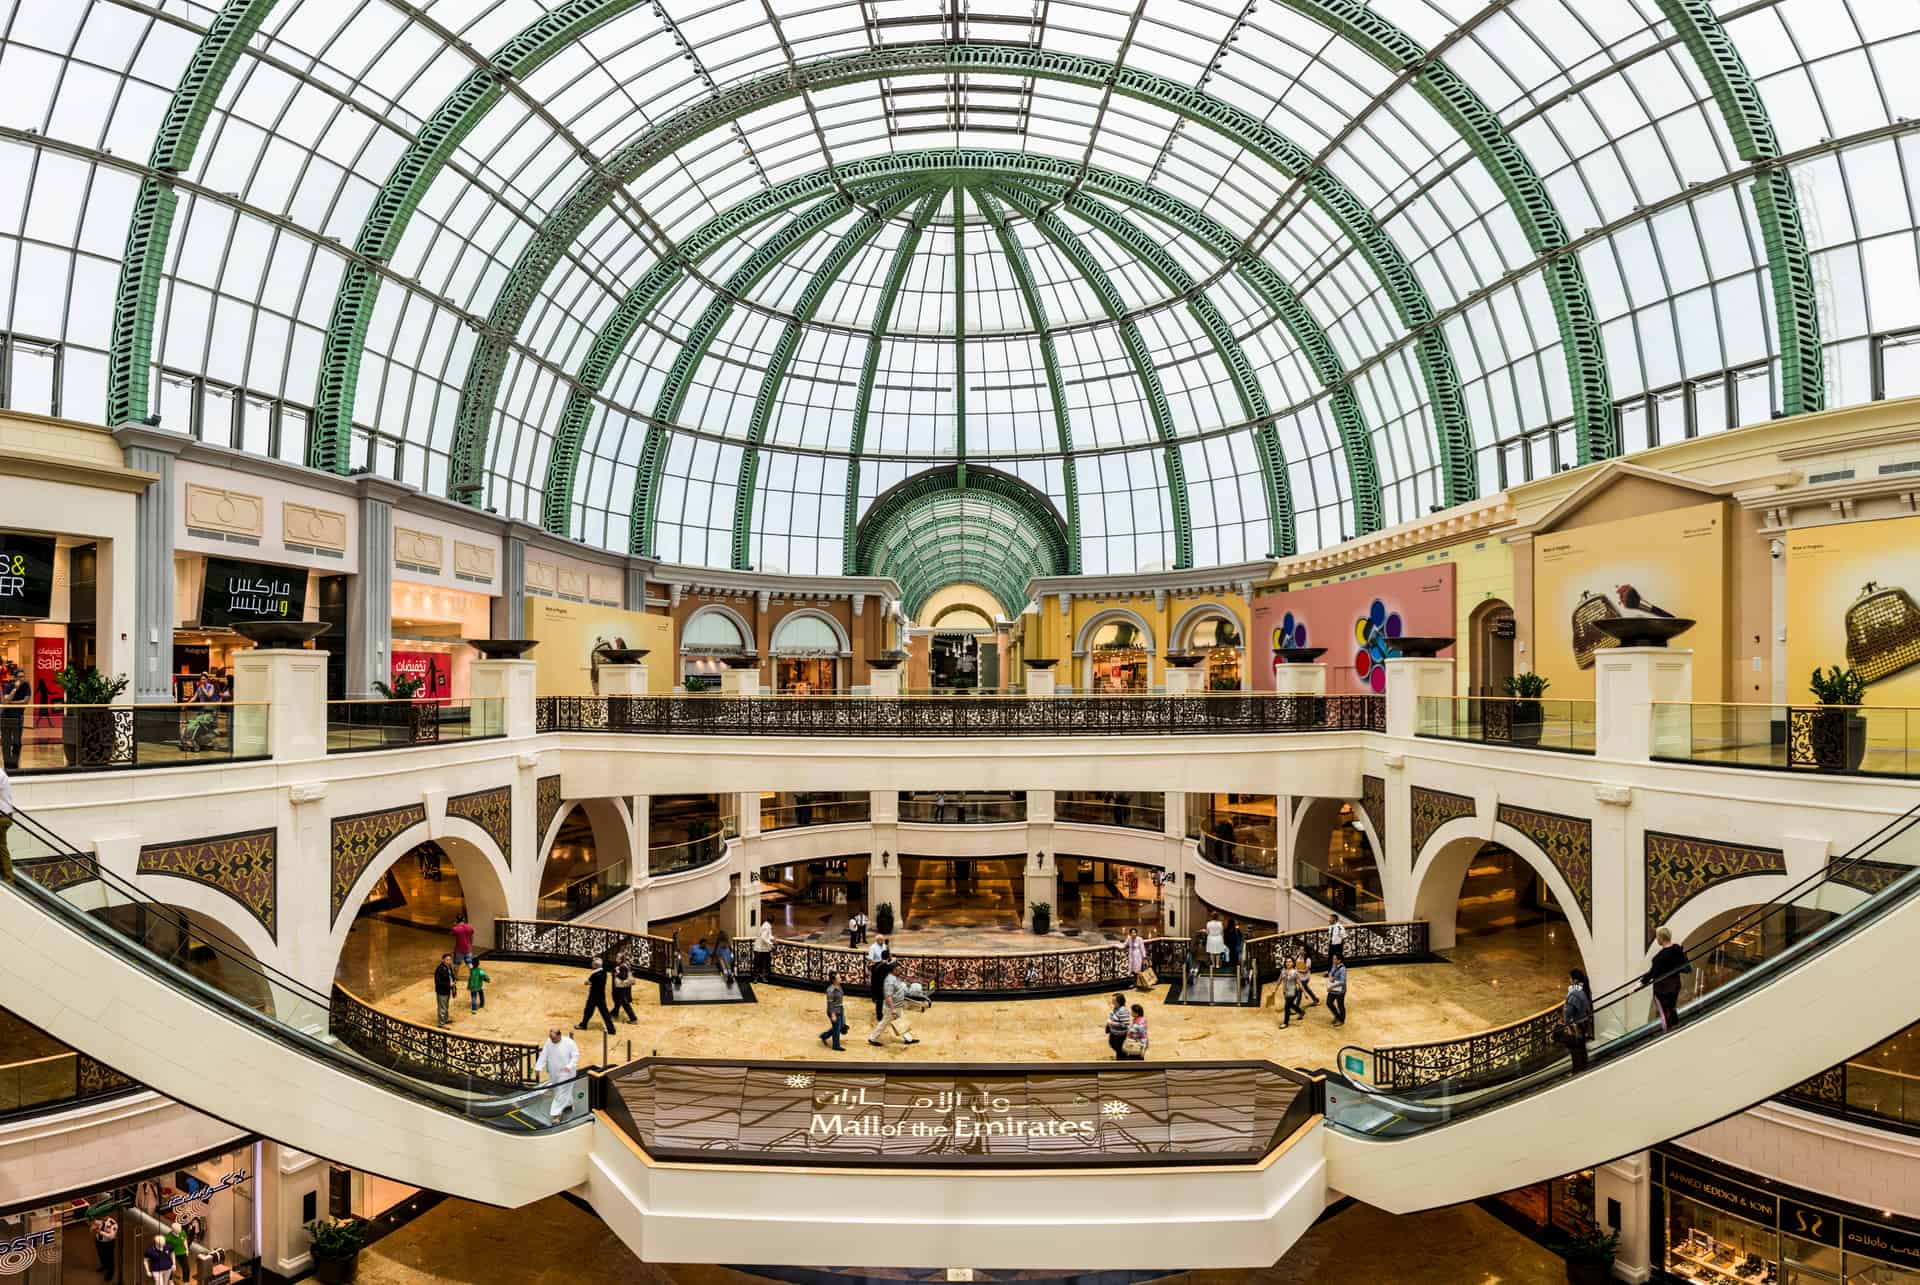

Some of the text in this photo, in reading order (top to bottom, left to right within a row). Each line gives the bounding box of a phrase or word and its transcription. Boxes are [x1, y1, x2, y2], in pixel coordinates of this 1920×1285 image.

[229, 576, 290, 597] ماركس
[38, 655, 62, 670] sale
[809, 1114, 1095, 1138] Mall of the Emirates
